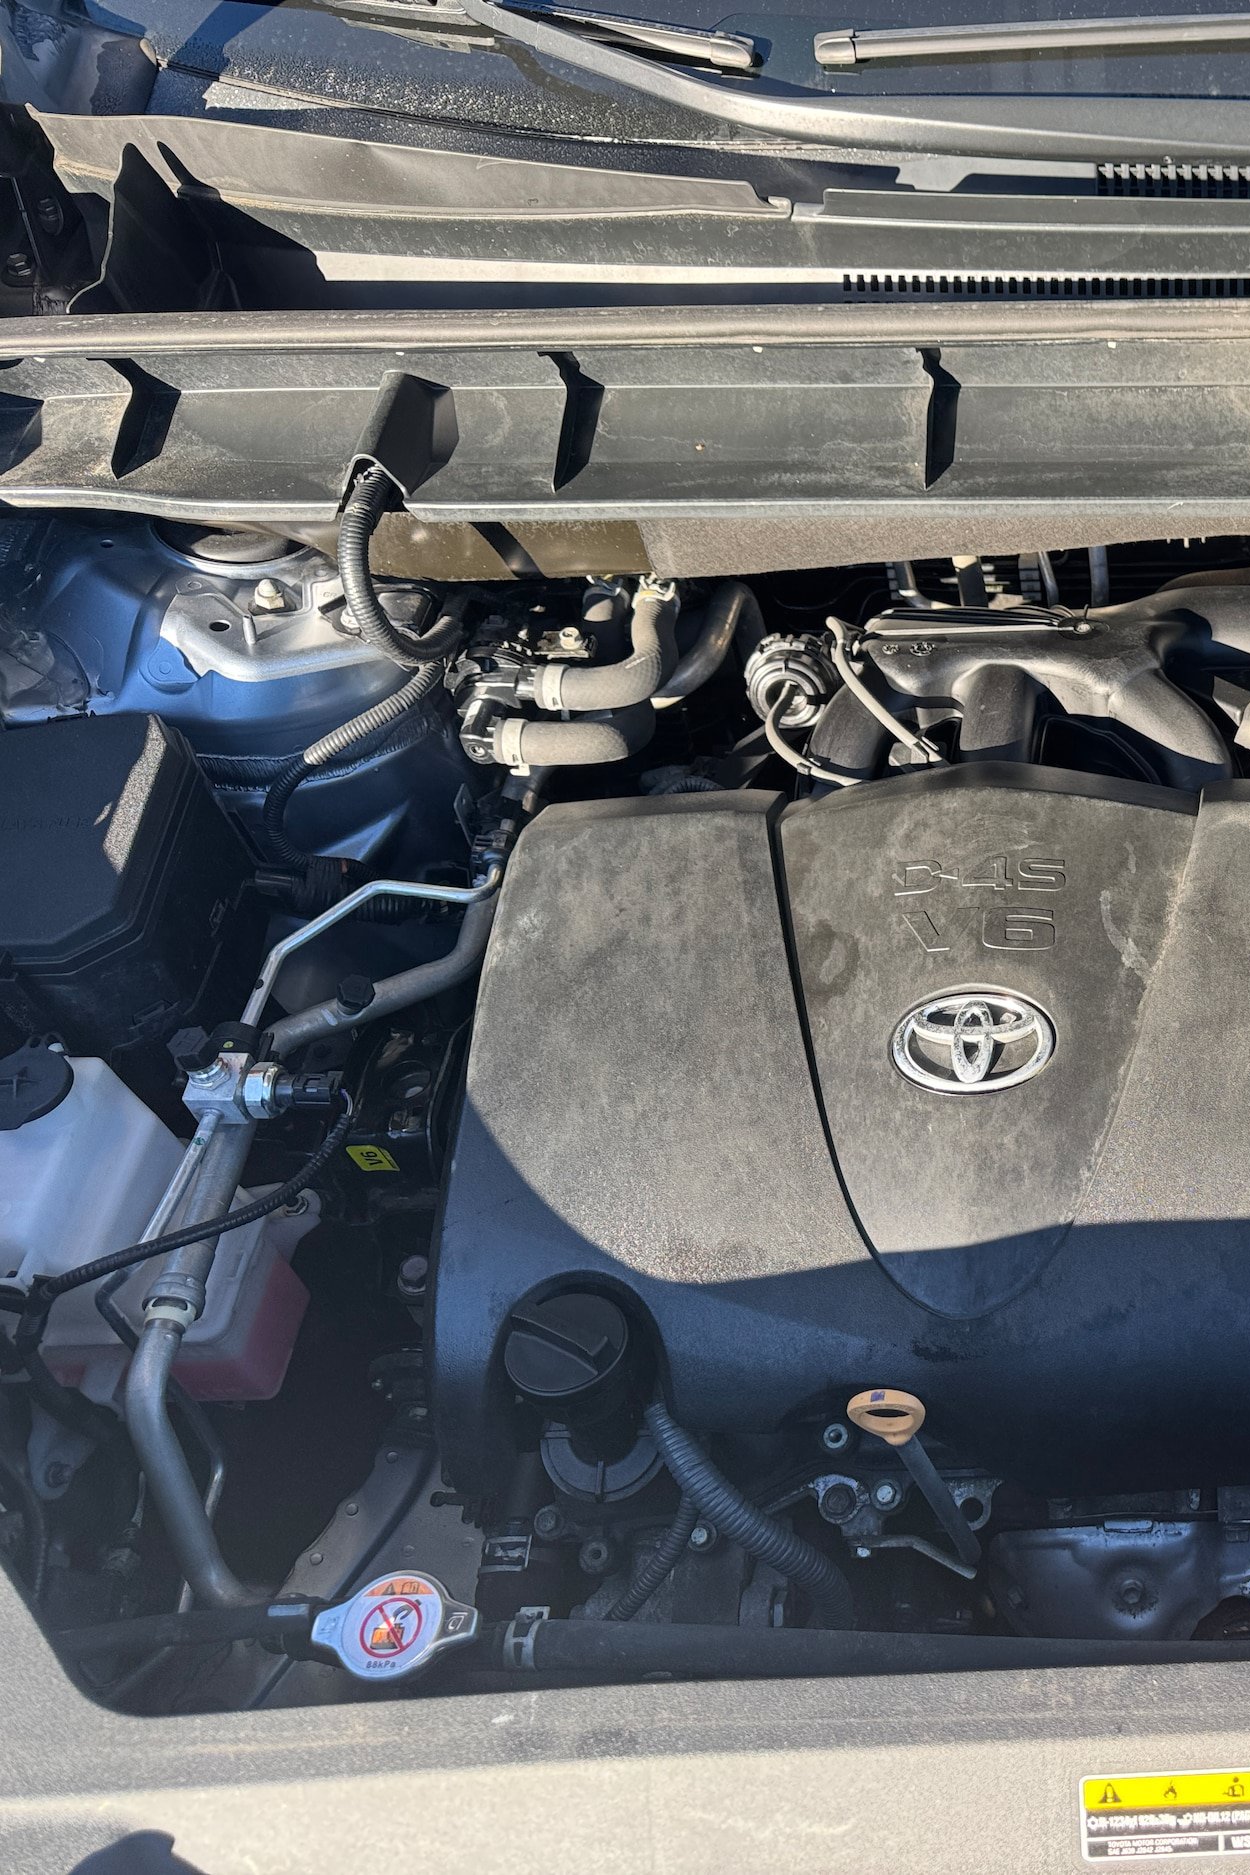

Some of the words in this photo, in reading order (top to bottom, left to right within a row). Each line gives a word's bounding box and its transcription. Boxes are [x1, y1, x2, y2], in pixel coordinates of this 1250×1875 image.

[892, 856, 1066, 896] D-4S
[902, 906, 1056, 952] V6
[360, 1151, 384, 1166] V6
[366, 1659, 396, 1669] 88kPa
[1108, 1840, 1132, 1848] TOYOTA
